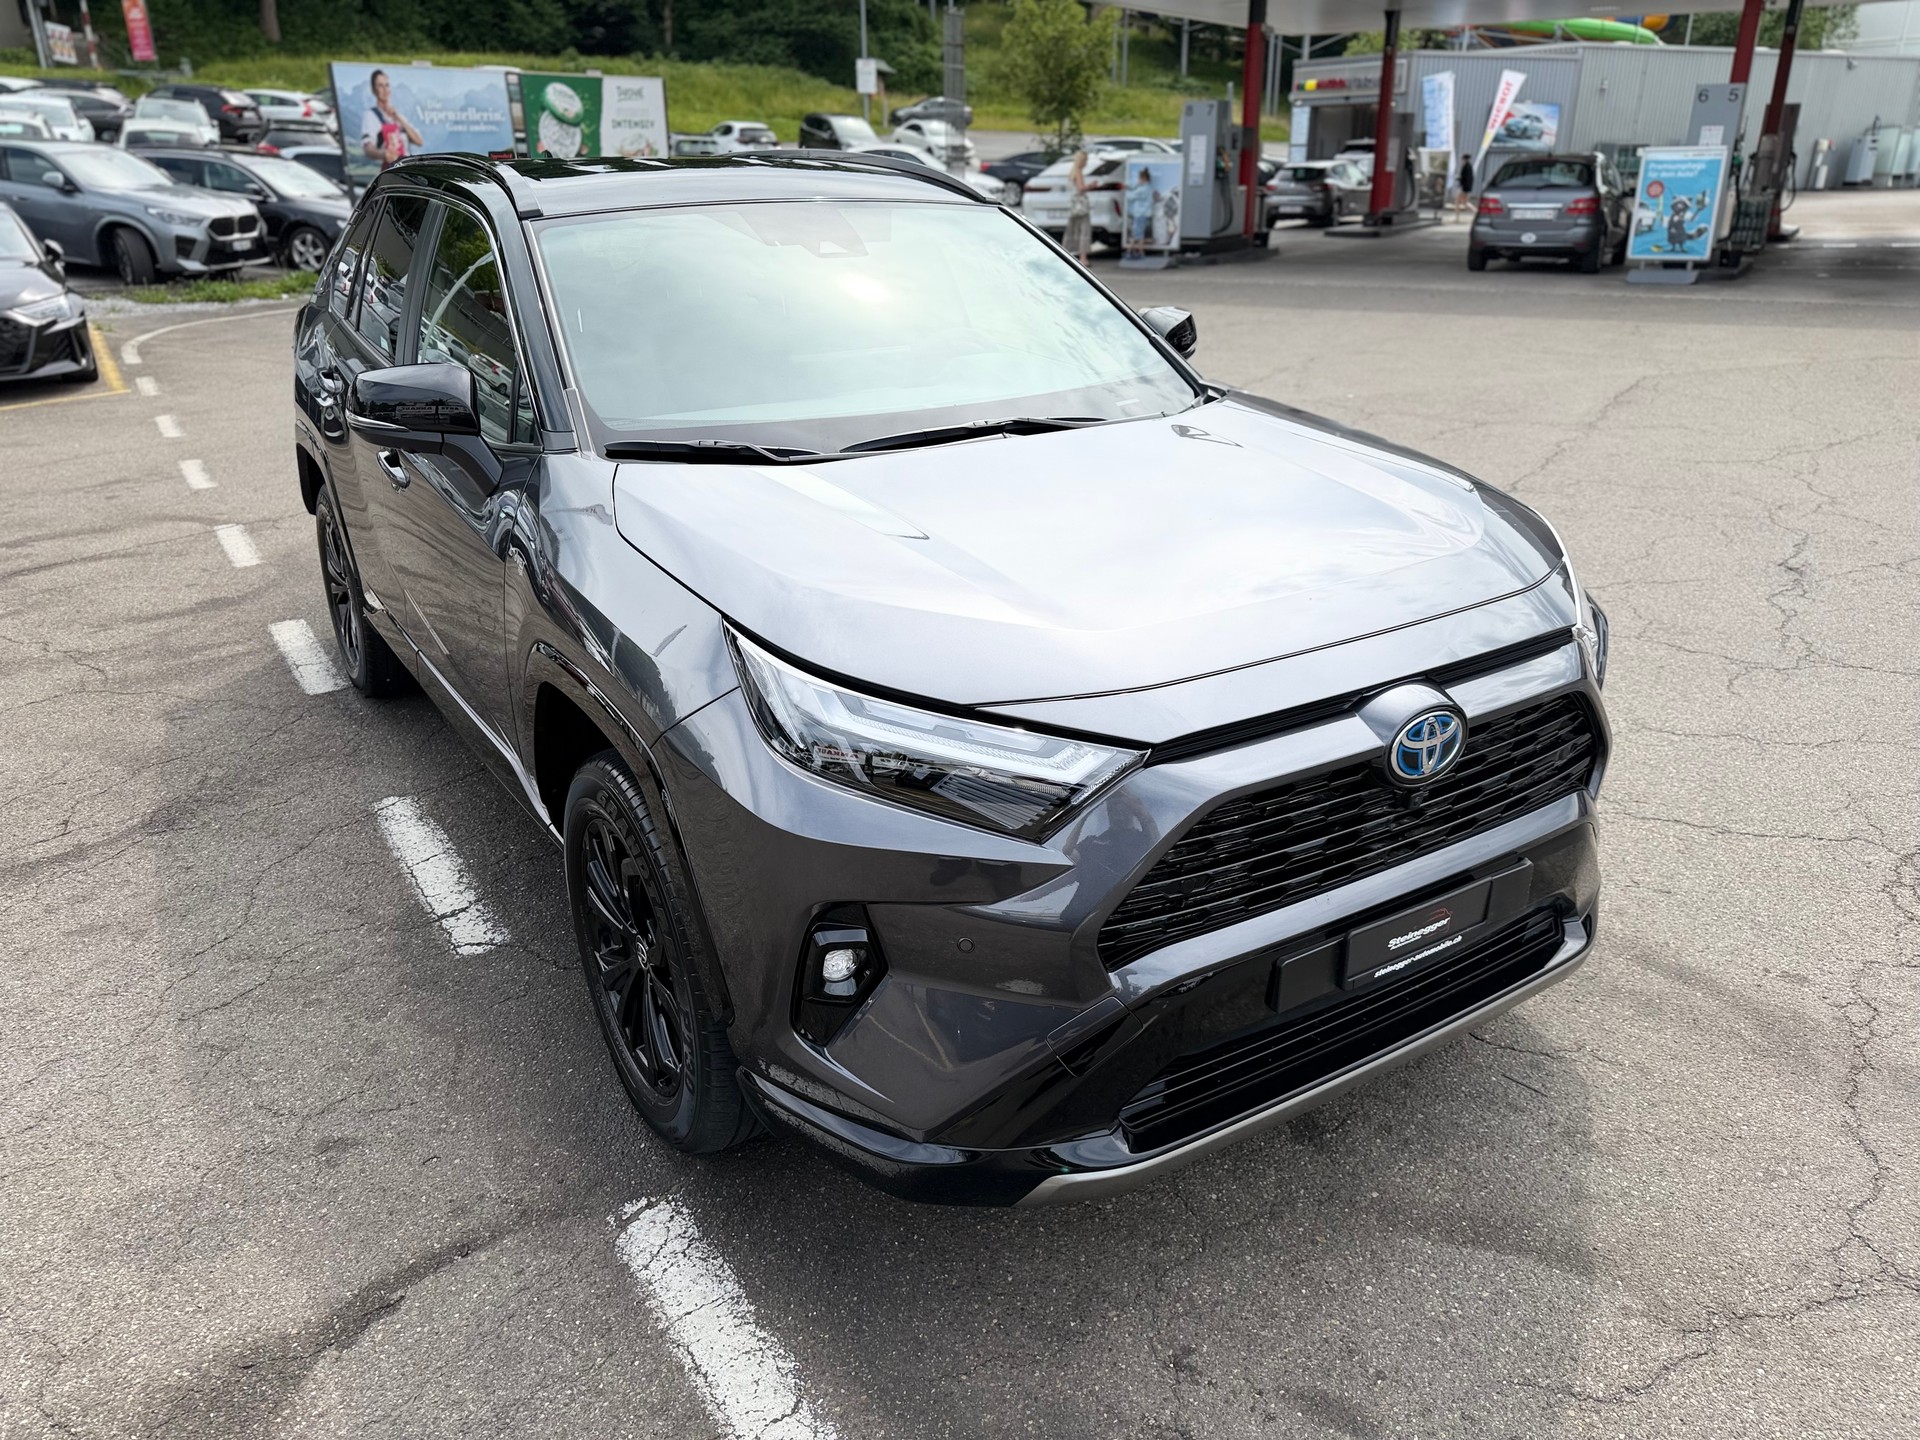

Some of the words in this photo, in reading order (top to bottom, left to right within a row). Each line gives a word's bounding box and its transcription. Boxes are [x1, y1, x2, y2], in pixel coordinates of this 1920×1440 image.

[1698, 88, 1709, 103] 6
[1728, 87, 1739, 103] 5
[1207, 103, 1215, 117] 7
[1388, 917, 1450, 947] Steinegger
